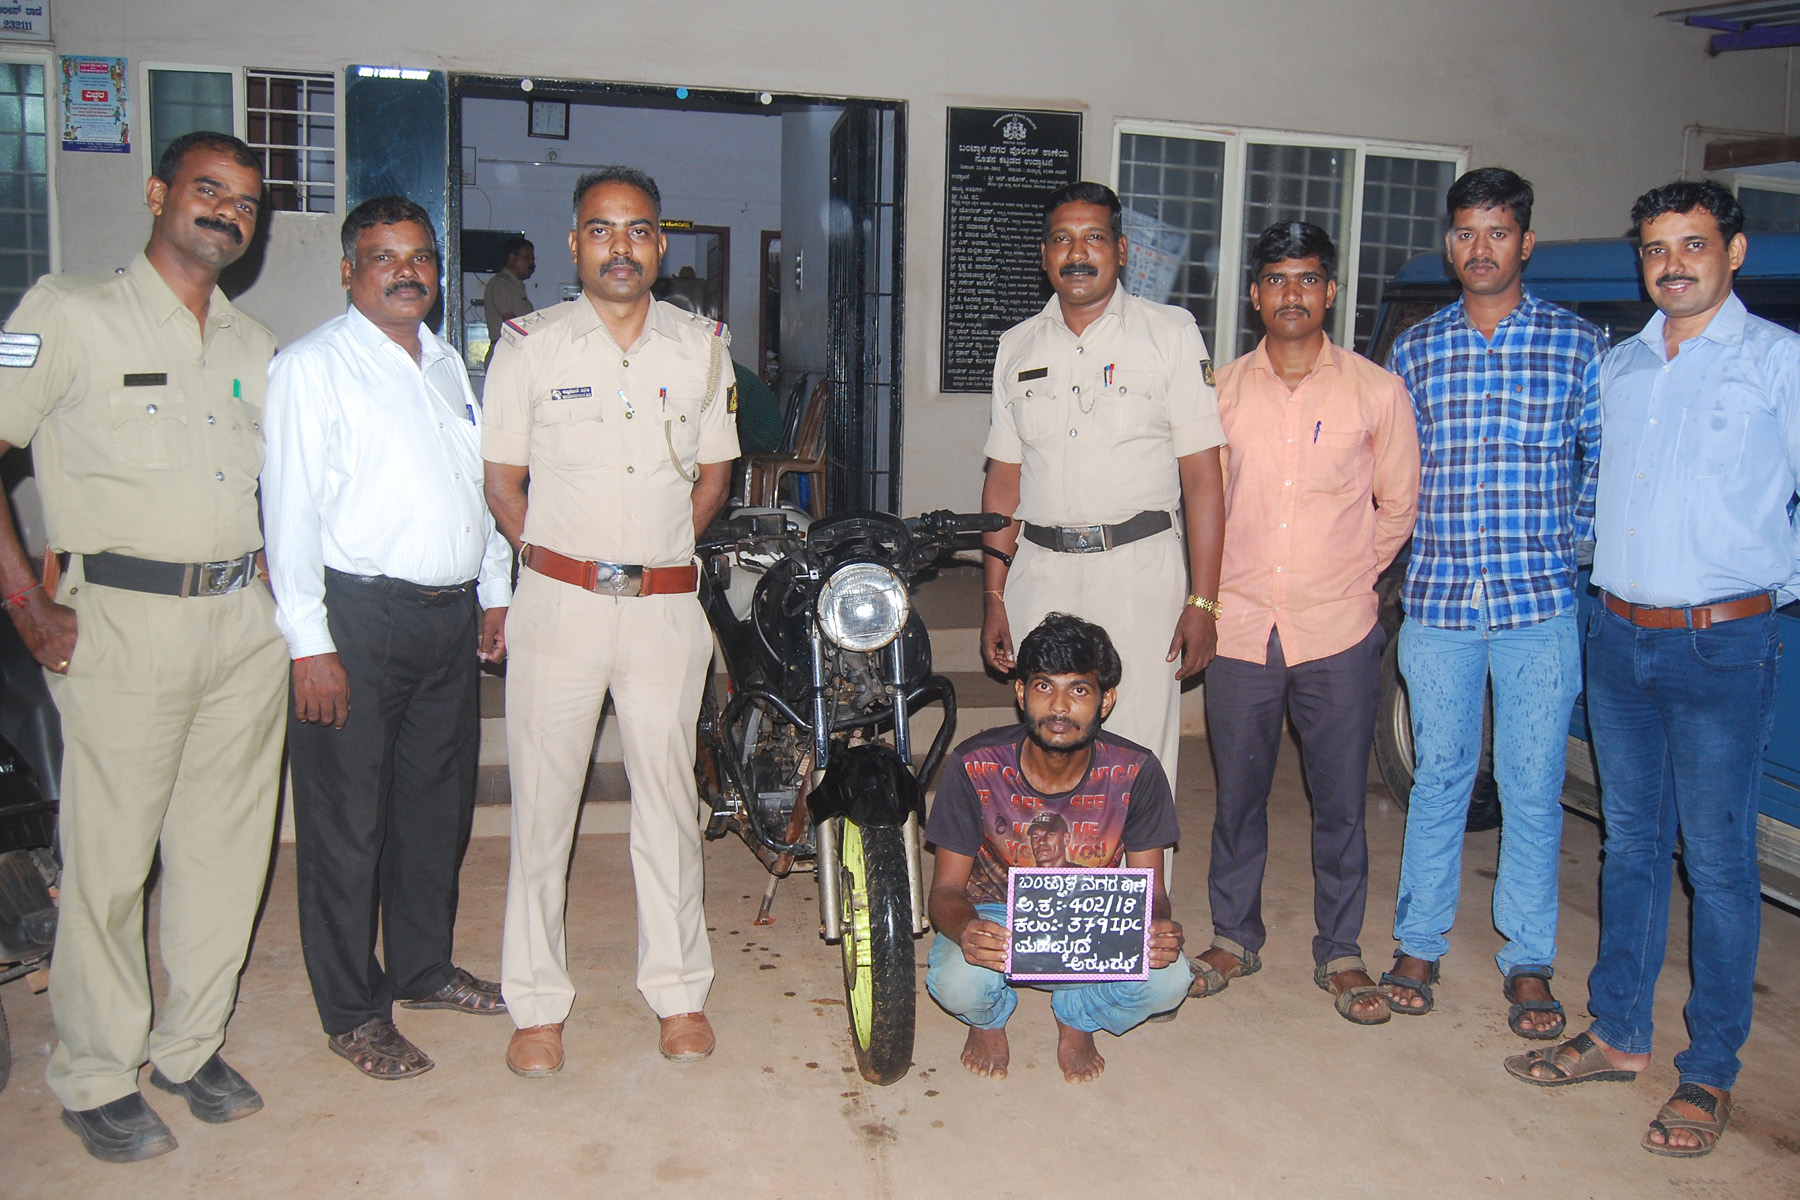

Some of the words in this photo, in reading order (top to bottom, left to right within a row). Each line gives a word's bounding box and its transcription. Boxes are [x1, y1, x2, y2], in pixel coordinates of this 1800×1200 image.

[4, 20, 32, 30] 232111
[989, 145, 1007, 154] ನಗರ
[1010, 793, 1047, 811] SEE
[1070, 794, 1107, 811] SEE
[1072, 821, 1100, 839] ME
[1081, 875, 1119, 892] ನಗರ
